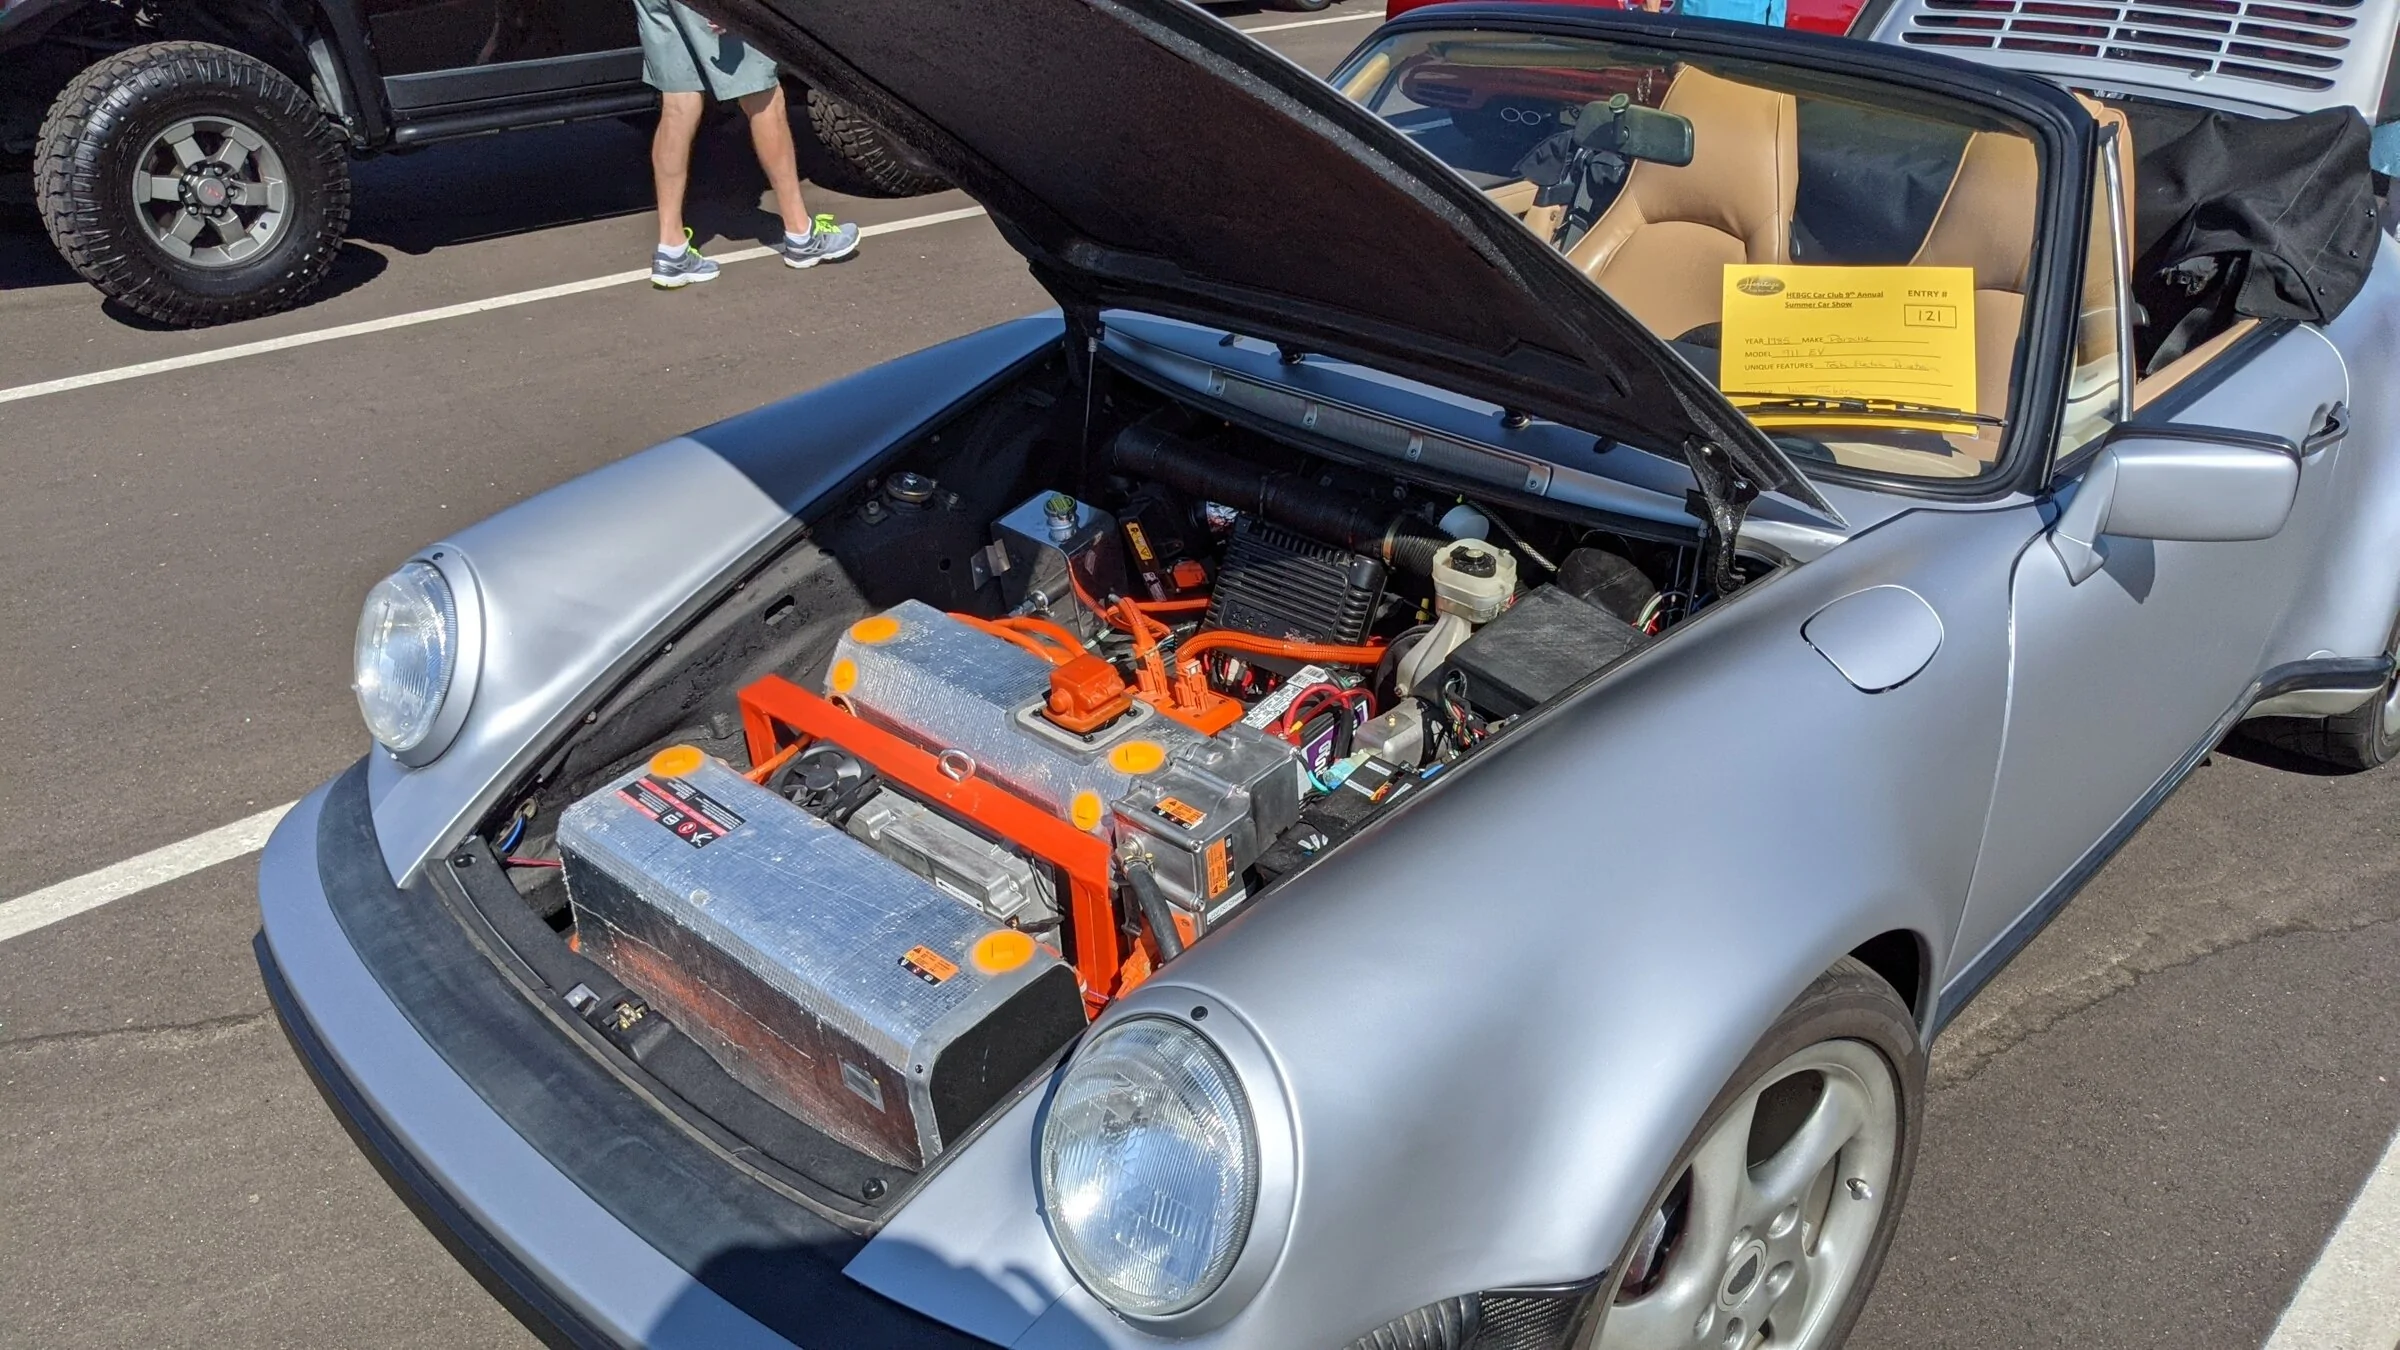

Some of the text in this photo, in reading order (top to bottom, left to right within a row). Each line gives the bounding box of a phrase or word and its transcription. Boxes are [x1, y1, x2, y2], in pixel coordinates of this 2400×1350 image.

[1785, 301, 1853, 309] Summer Car Show
[1919, 310, 1940, 322] 121
